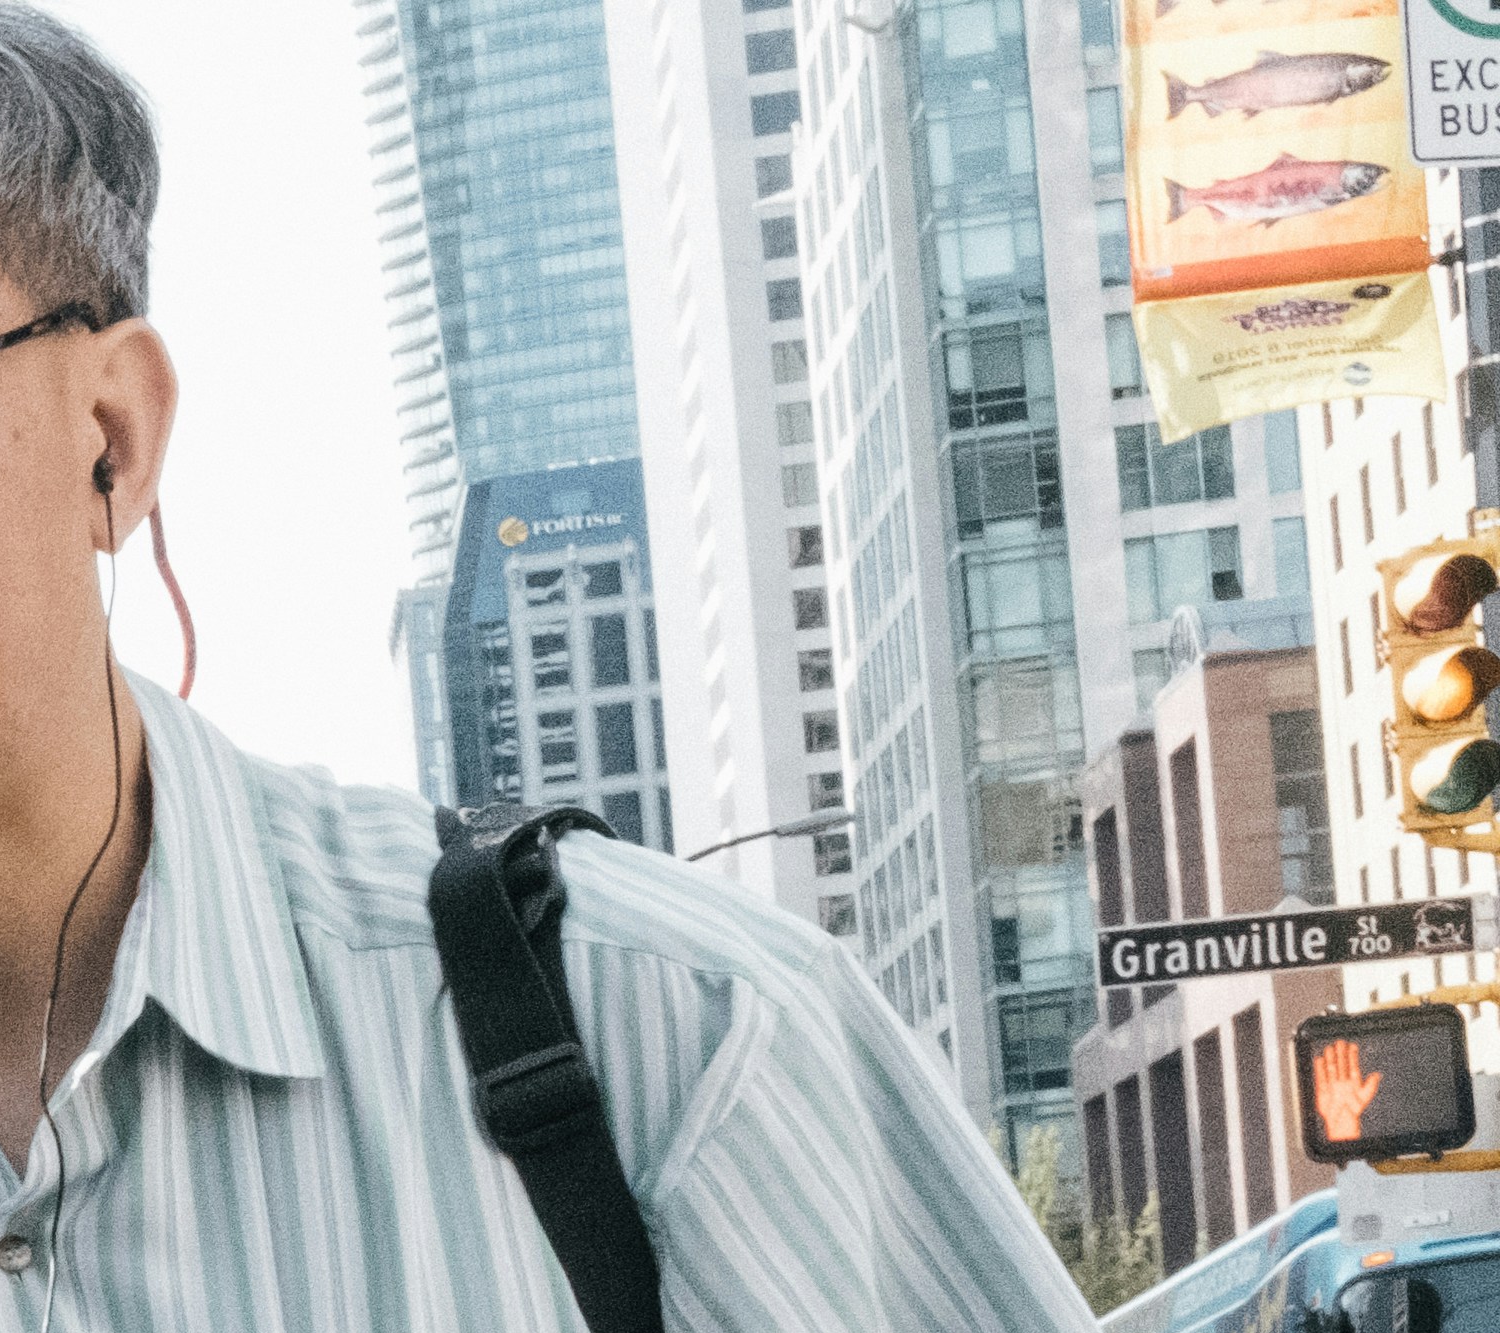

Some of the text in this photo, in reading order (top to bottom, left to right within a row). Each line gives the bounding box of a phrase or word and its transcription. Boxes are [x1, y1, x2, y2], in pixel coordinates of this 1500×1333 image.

[1431, 57, 1500, 92] EXC
[1441, 103, 1500, 136] BU
[1112, 915, 1379, 979] Granville St
[1348, 935, 1392, 956] 700
